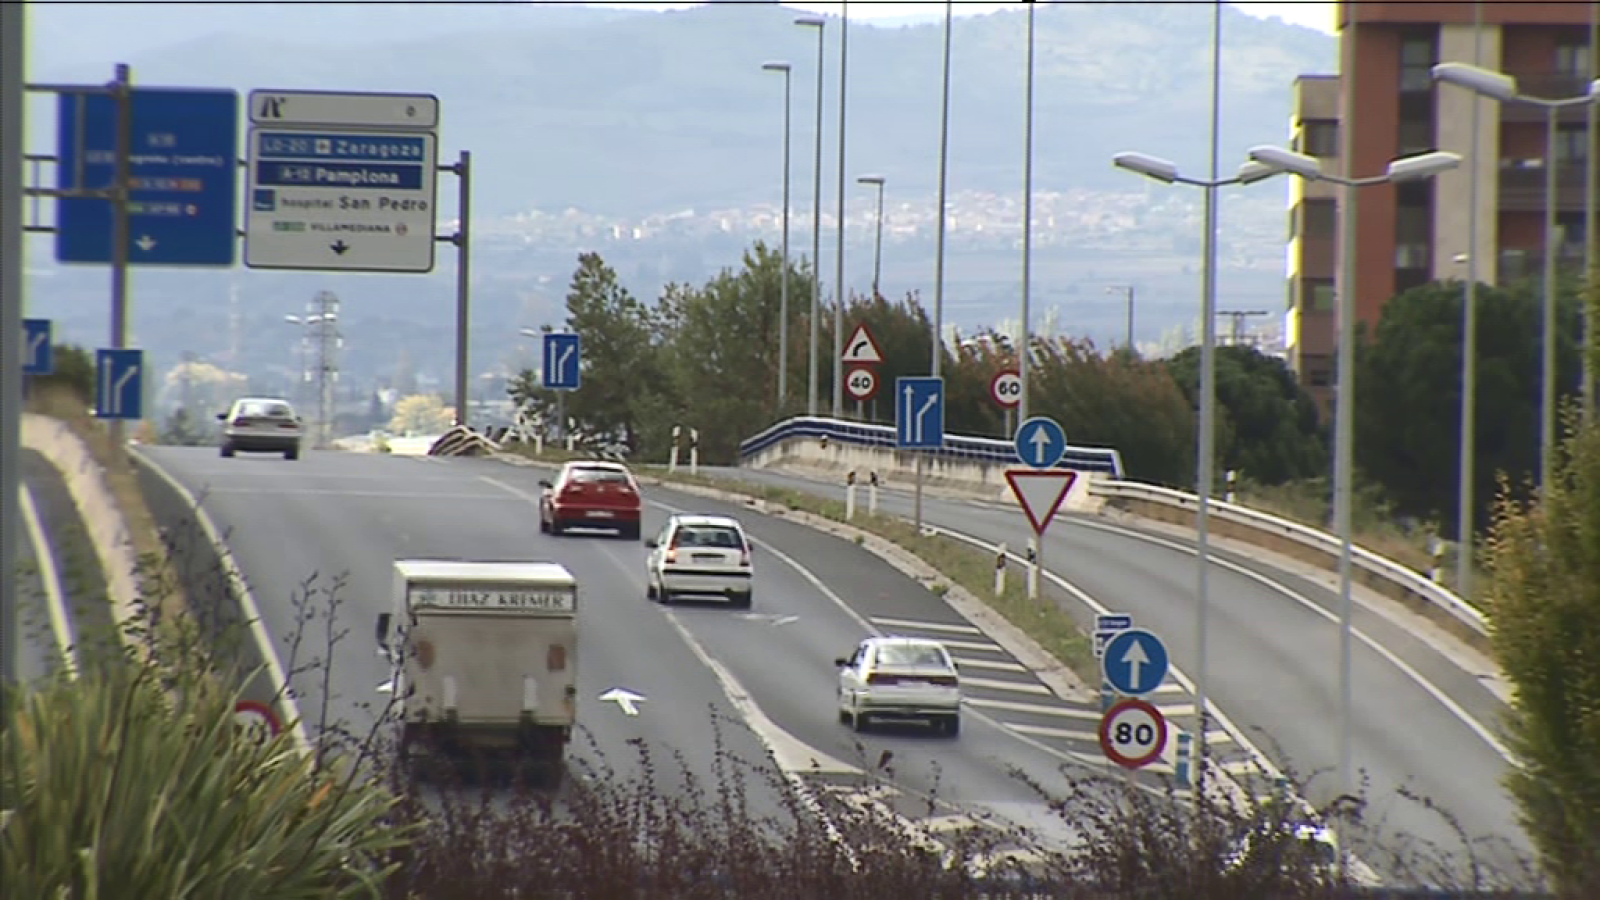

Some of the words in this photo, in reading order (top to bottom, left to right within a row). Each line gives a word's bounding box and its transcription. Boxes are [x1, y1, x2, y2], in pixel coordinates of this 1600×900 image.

[335, 140, 421, 158] Zaragoza
[315, 168, 399, 185] Pamplona
[280, 198, 333, 209] hospital
[339, 196, 371, 210] San
[379, 196, 428, 212] Pedro
[310, 223, 391, 233] VILLAMEDIANA
[851, 376, 871, 389] 40
[997, 381, 1020, 396] 60
[1114, 721, 1154, 746] 80
